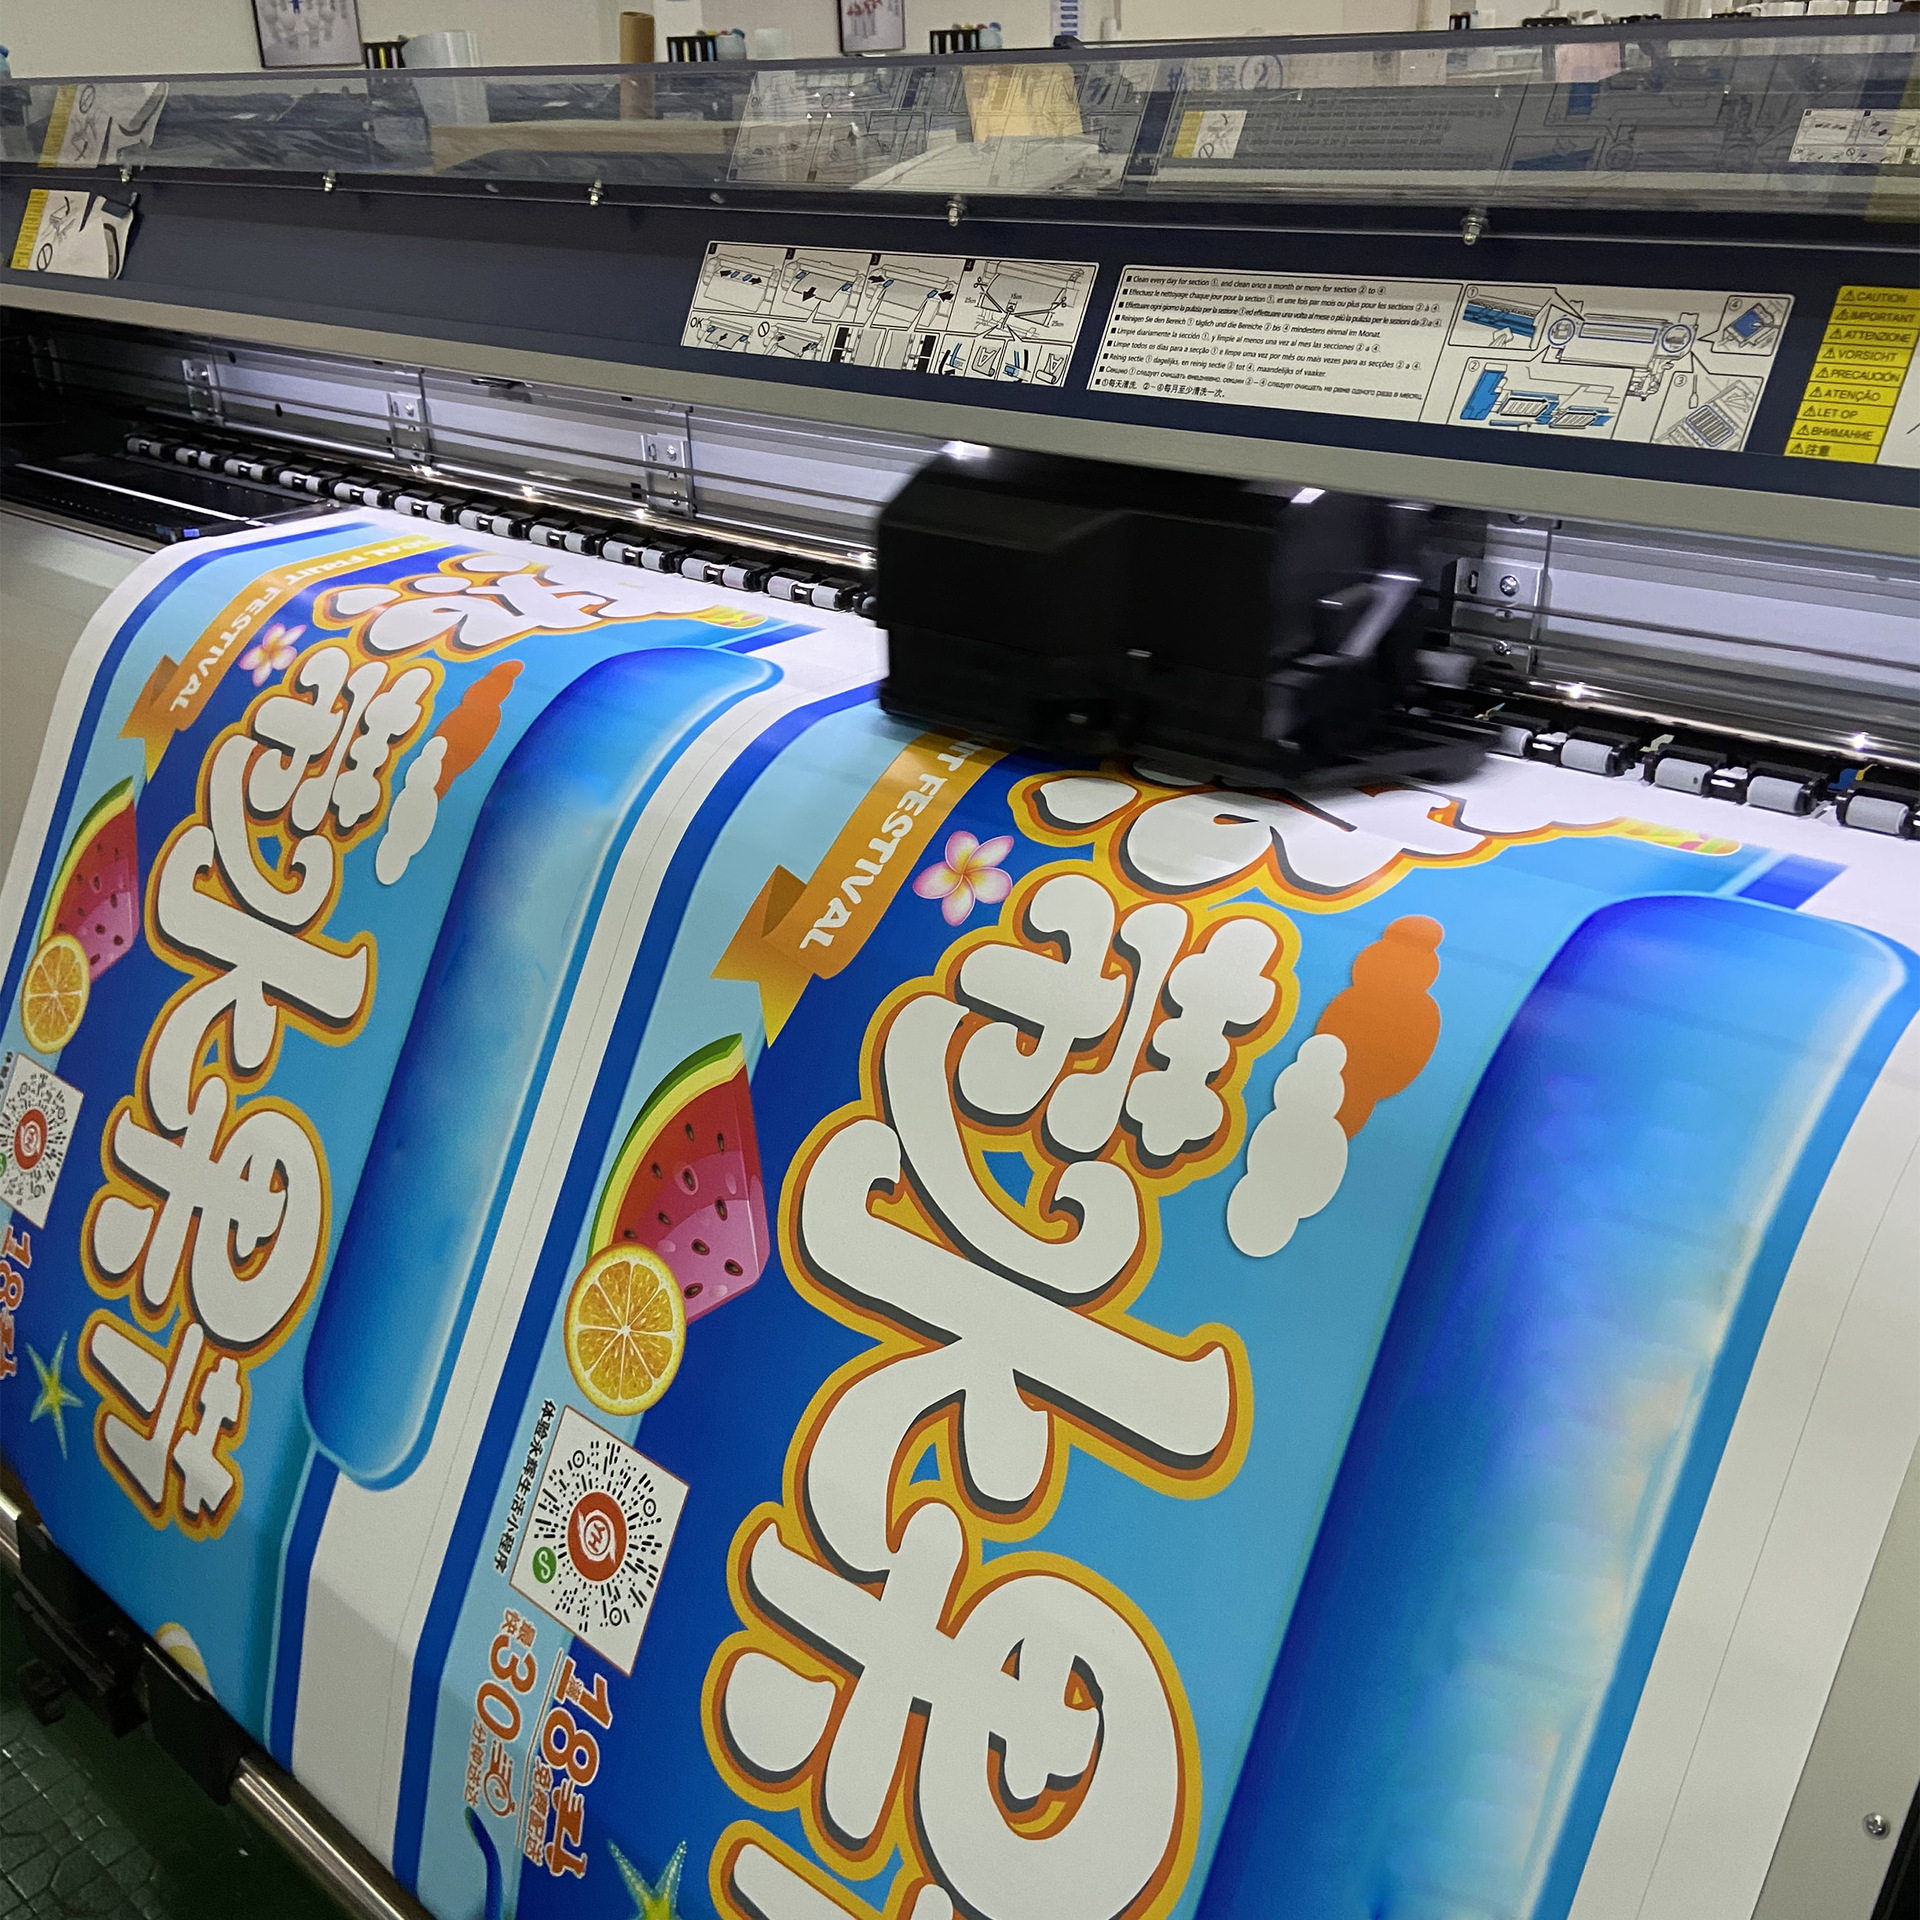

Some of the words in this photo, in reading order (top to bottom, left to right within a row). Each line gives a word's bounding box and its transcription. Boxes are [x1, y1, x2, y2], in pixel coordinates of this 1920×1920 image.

[1133, 275, 1149, 283] Clean
[1150, 277, 1166, 285] every
[1166, 277, 1178, 286] day
[1177, 277, 1188, 285] for
[1187, 277, 1209, 286] section
[1220, 279, 1233, 287] and
[1233, 279, 1250, 288] clean
[1251, 282, 1267, 291] once
[1272, 281, 1294, 290] month
[1322, 284, 1332, 294] for
[1333, 285, 1357, 295] section
[1128, 288, 1154, 296] Effectuez
[1160, 291, 1188, 299] nettoyage
[1189, 291, 1210, 300] chaque
[1209, 293, 1223, 301] jour
[1297, 297, 1308, 305] fois
[1345, 300, 1360, 309] plus
[1359, 302, 1377, 310] pour
[1377, 301, 1387, 309] les
[1387, 303, 1414, 311] sections
[1857, 292, 1908, 303] CAUTION
[690, 317, 703, 328] OK
[1851, 311, 1915, 323] IMPORTANT
[1121, 314, 1144, 323] Reinigen
[1195, 319, 1214, 328] täglich
[1237, 322, 1263, 330] Bereiche
[1290, 326, 1325, 334] mindestens
[1358, 330, 1380, 338] Monat.
[1117, 328, 1135, 336] Limpie
[1136, 329, 1171, 337] diariamente
[1216, 334, 1235, 343] limpie
[1844, 329, 1911, 343] ATTENZIONE
[1113, 340, 1130, 348] Limpe
[1224, 349, 1241, 357] limpe
[1839, 349, 1897, 362] VORSICHT
[1109, 353, 1126, 362] Reinig
[1153, 356, 1179, 366] dagelijks,
[1190, 361, 1207, 369] reinig
[1256, 366, 1293, 375] maandelijks
[1304, 369, 1325, 377] vaaker.
[1824, 389, 1881, 402] ATENÇÃO
[1817, 408, 1838, 418] LET
[1841, 410, 1858, 419] OP
[1811, 427, 1874, 440] ВНИМАНИЕ
[1805, 444, 1831, 457] 注意
[170, 586, 282, 712] FESTIVAL
[799, 773, 949, 949] FESTIVAL
[495, 1399, 557, 1575] 体验永辉生活小程序
[587, 1523, 606, 1553] YH
[541, 1656, 613, 1787] 18
